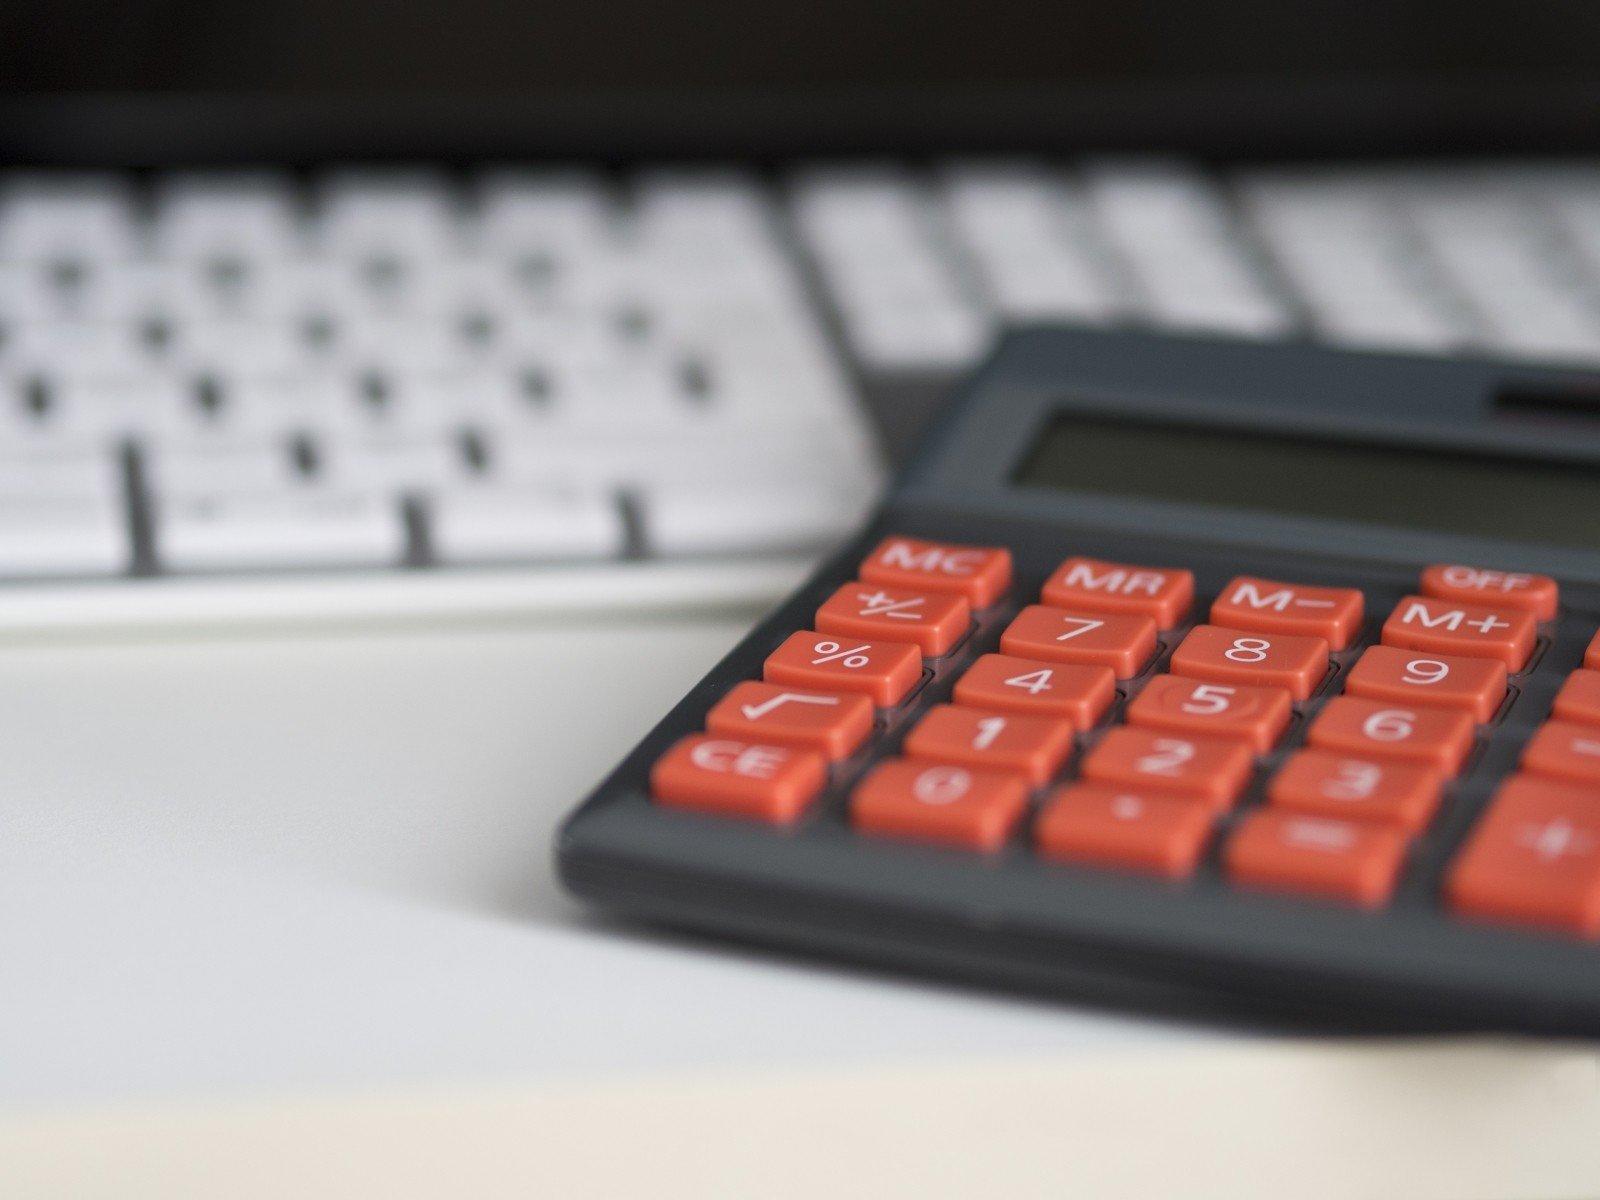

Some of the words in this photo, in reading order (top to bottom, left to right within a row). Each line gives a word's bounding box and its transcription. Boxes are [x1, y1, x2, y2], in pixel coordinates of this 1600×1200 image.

[880, 542, 986, 574] MC
[1065, 565, 1166, 595] MR
[1442, 566, 1533, 592] OFF
[1056, 616, 1105, 642] 7
[1402, 603, 1511, 634] M+
[811, 640, 872, 668] %
[1224, 638, 1271, 663] 8
[1004, 669, 1054, 694] 4
[1401, 659, 1449, 685] 9
[1182, 684, 1237, 716] 5
[972, 716, 1007, 750] 1
[1362, 710, 1416, 742] 6
[690, 739, 790, 780] CE
[1137, 739, 1196, 777] 2
[913, 765, 972, 805] 0
[1322, 760, 1382, 800] 3
